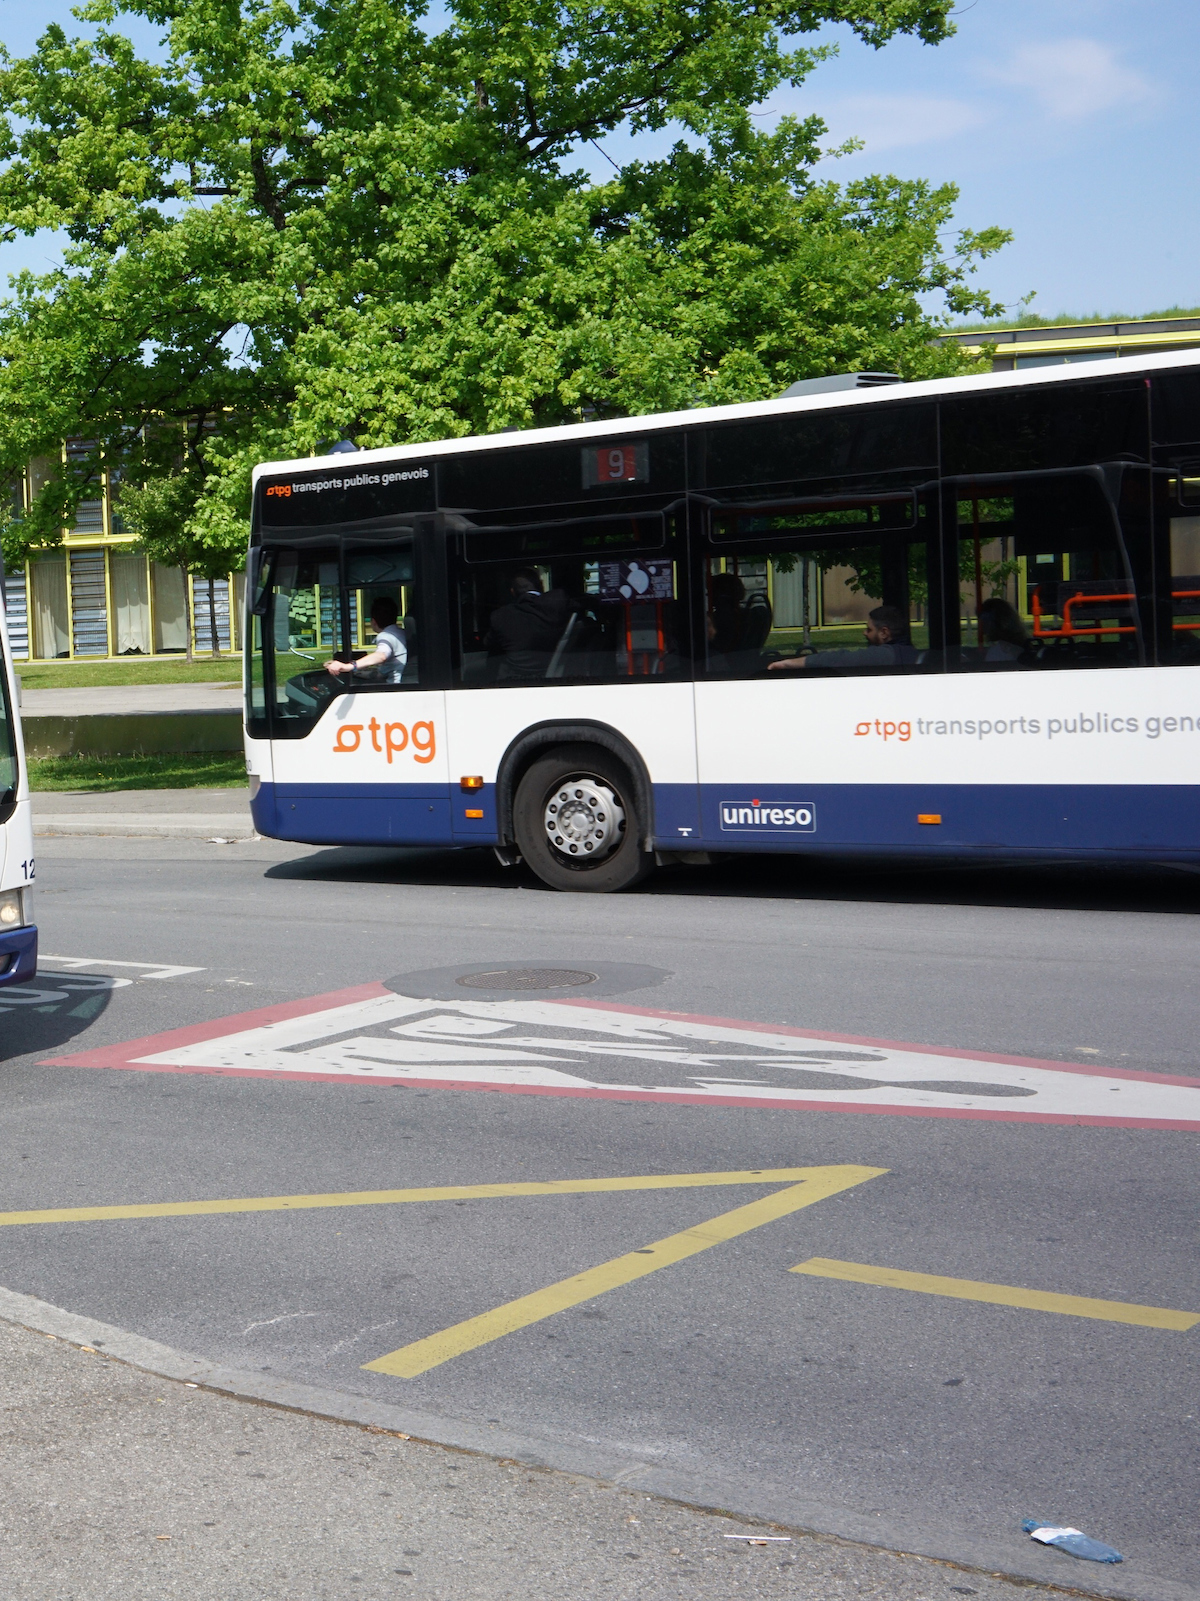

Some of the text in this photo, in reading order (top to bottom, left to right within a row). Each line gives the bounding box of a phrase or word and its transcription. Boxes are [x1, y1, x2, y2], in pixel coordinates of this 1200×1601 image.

[608, 450, 624, 478] 9
[292, 479, 342, 493] transports
[343, 474, 380, 490] publics
[381, 467, 429, 486] genevois
[917, 716, 1041, 741] transports
[1047, 712, 1139, 740] publics
[723, 799, 812, 825] unireso
